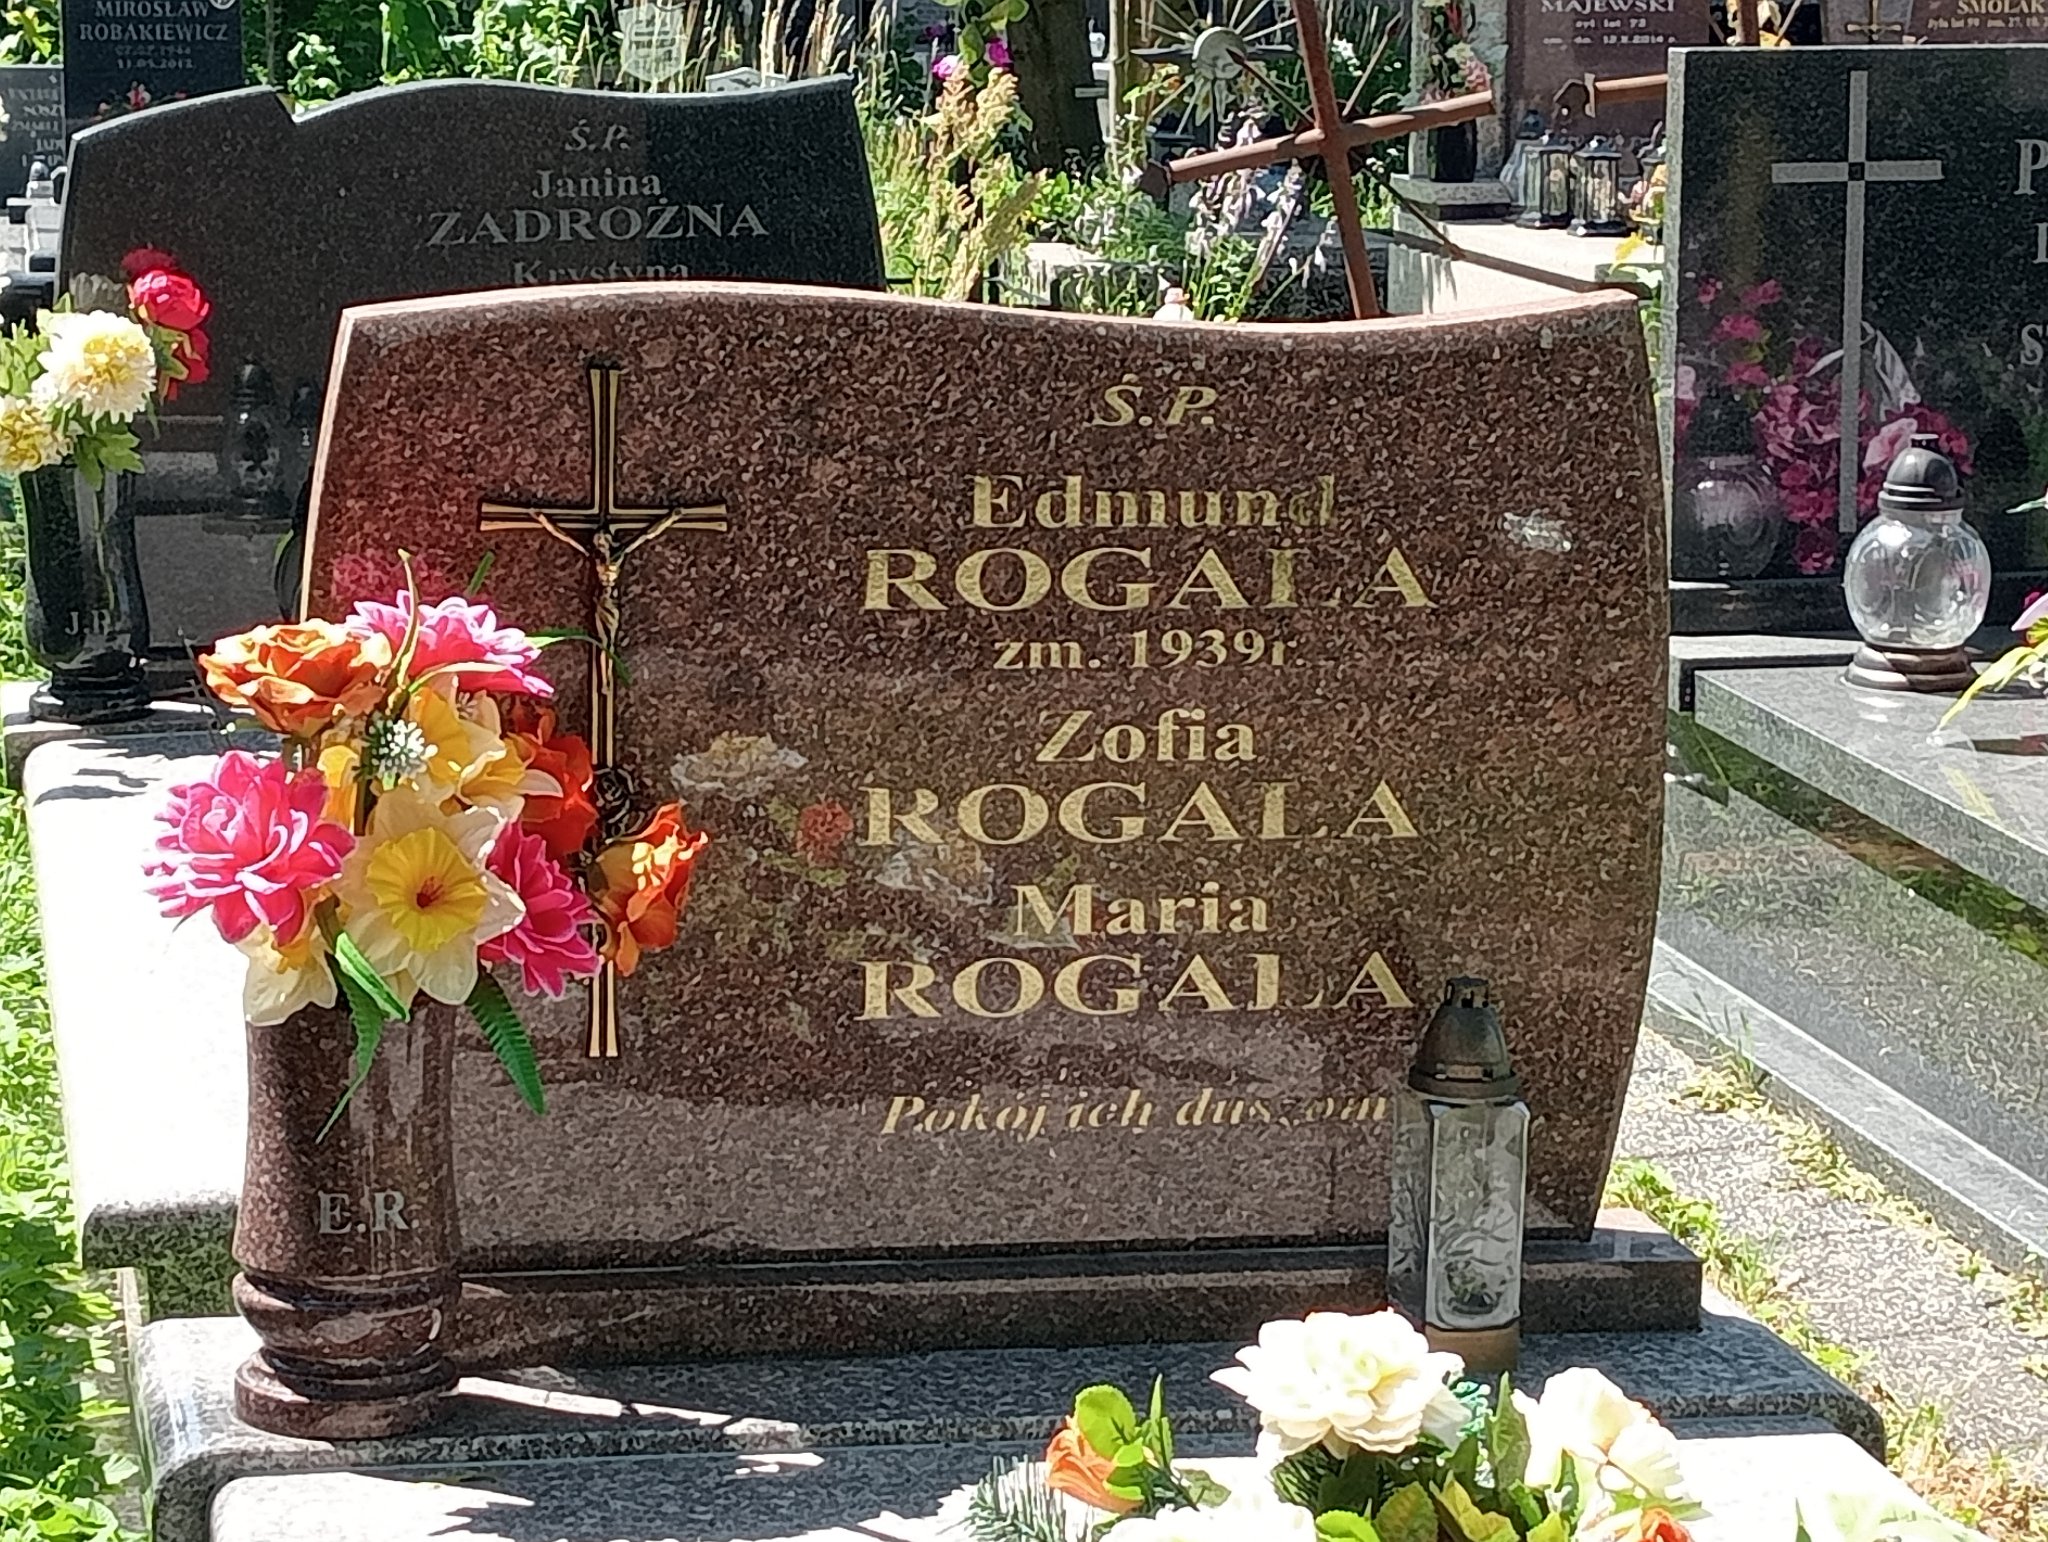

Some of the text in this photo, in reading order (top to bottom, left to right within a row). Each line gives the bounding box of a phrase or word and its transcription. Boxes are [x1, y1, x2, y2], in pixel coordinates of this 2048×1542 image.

[79, 23, 229, 42] ROBAKIEWICZ
[531, 167, 662, 199] Janina
[426, 197, 769, 247] ZADROŻNA
[969, 474, 1337, 529] Edmund
[992, 640, 1101, 670] zm.
[1035, 708, 1258, 763] Zofia
[858, 780, 1421, 847] ROGALA
[1010, 881, 1269, 938] Maria
[852, 951, 1415, 1022] ROGALA
